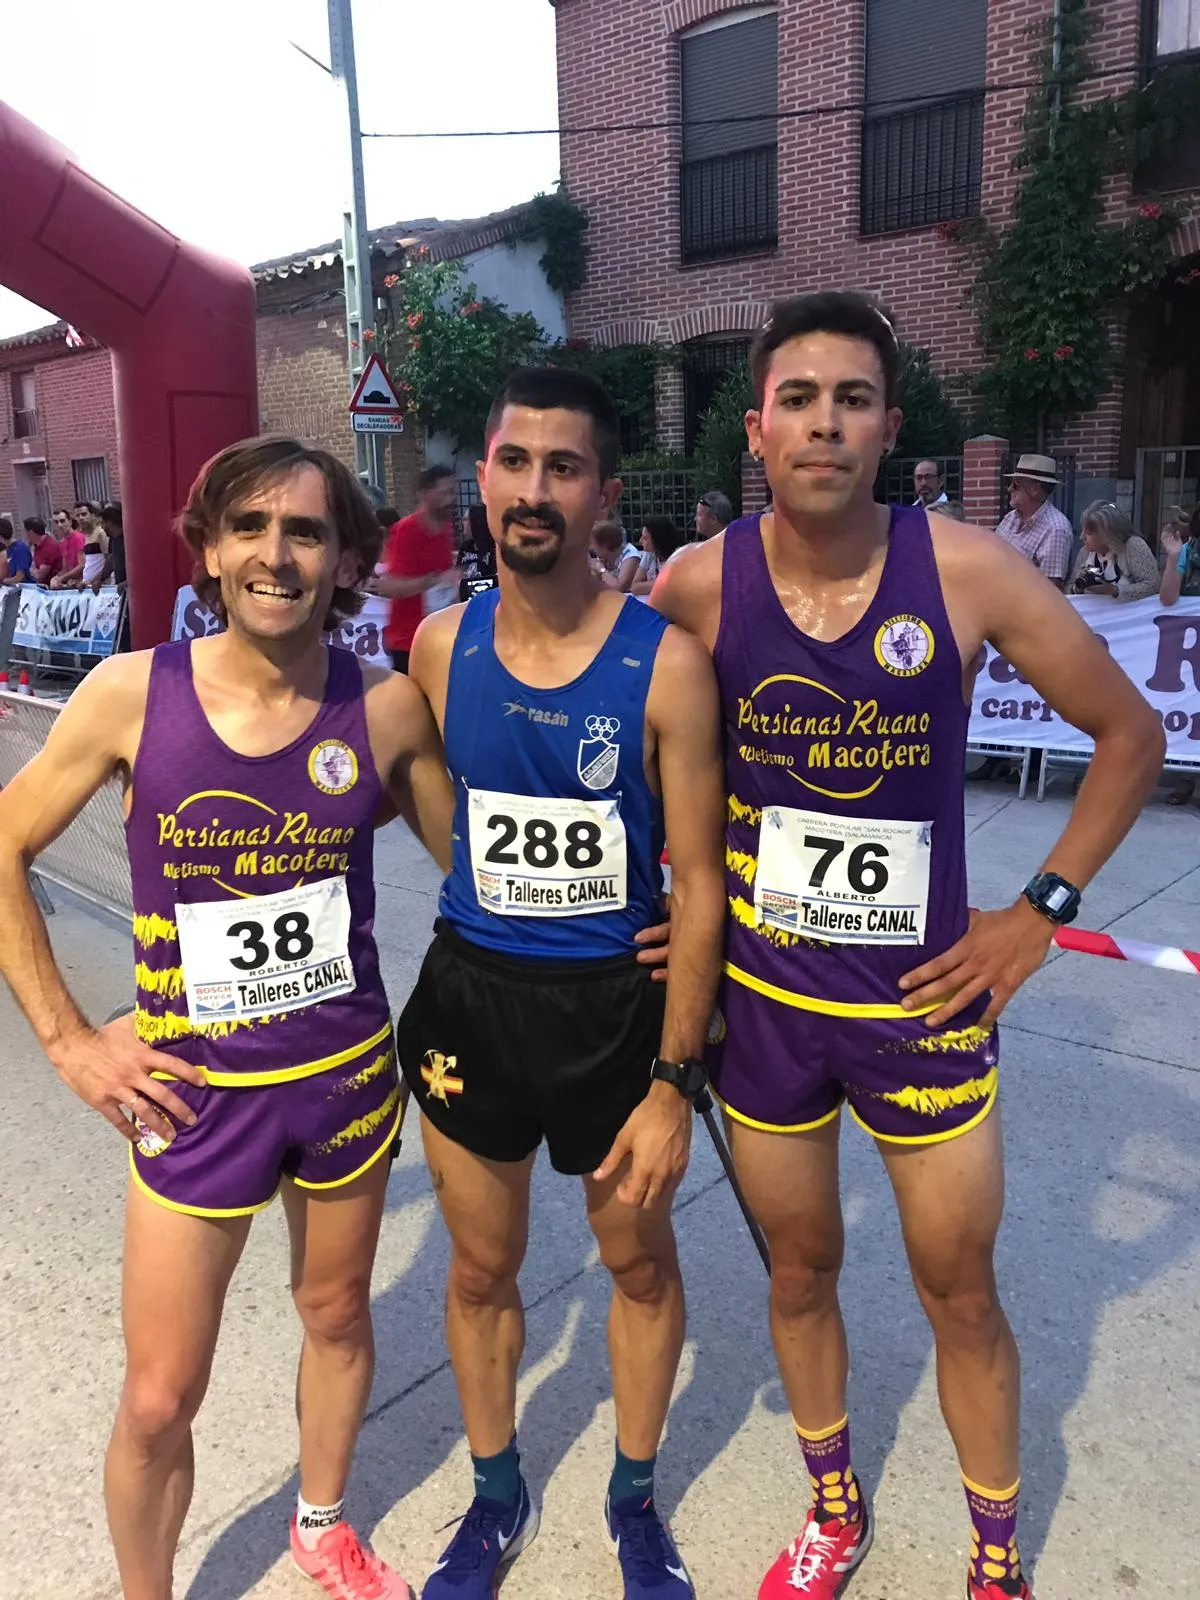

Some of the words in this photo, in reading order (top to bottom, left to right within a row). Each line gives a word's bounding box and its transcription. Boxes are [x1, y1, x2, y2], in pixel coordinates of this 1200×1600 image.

[737, 697, 841, 736] Persianas
[846, 699, 930, 736] Ruano
[739, 744, 795, 767] Atletismo
[807, 739, 931, 771] Macotera
[156, 812, 271, 848] Persianas
[274, 811, 355, 845] Ruano
[484, 813, 604, 870] 288
[234, 848, 350, 876] Macotera
[803, 834, 890, 895] 76
[506, 879, 563, 905] Talleres
[567, 879, 618, 904] CANAL
[763, 893, 796, 905] BOSCH
[816, 889, 876, 902] ALBERTO
[801, 901, 863, 931] Talleres
[867, 909, 918, 932] CANAL
[226, 911, 314, 971] 38
[249, 959, 309, 977] ROBERTO
[195, 985, 233, 995] BOSCH
[238, 980, 301, 1007] Talleres
